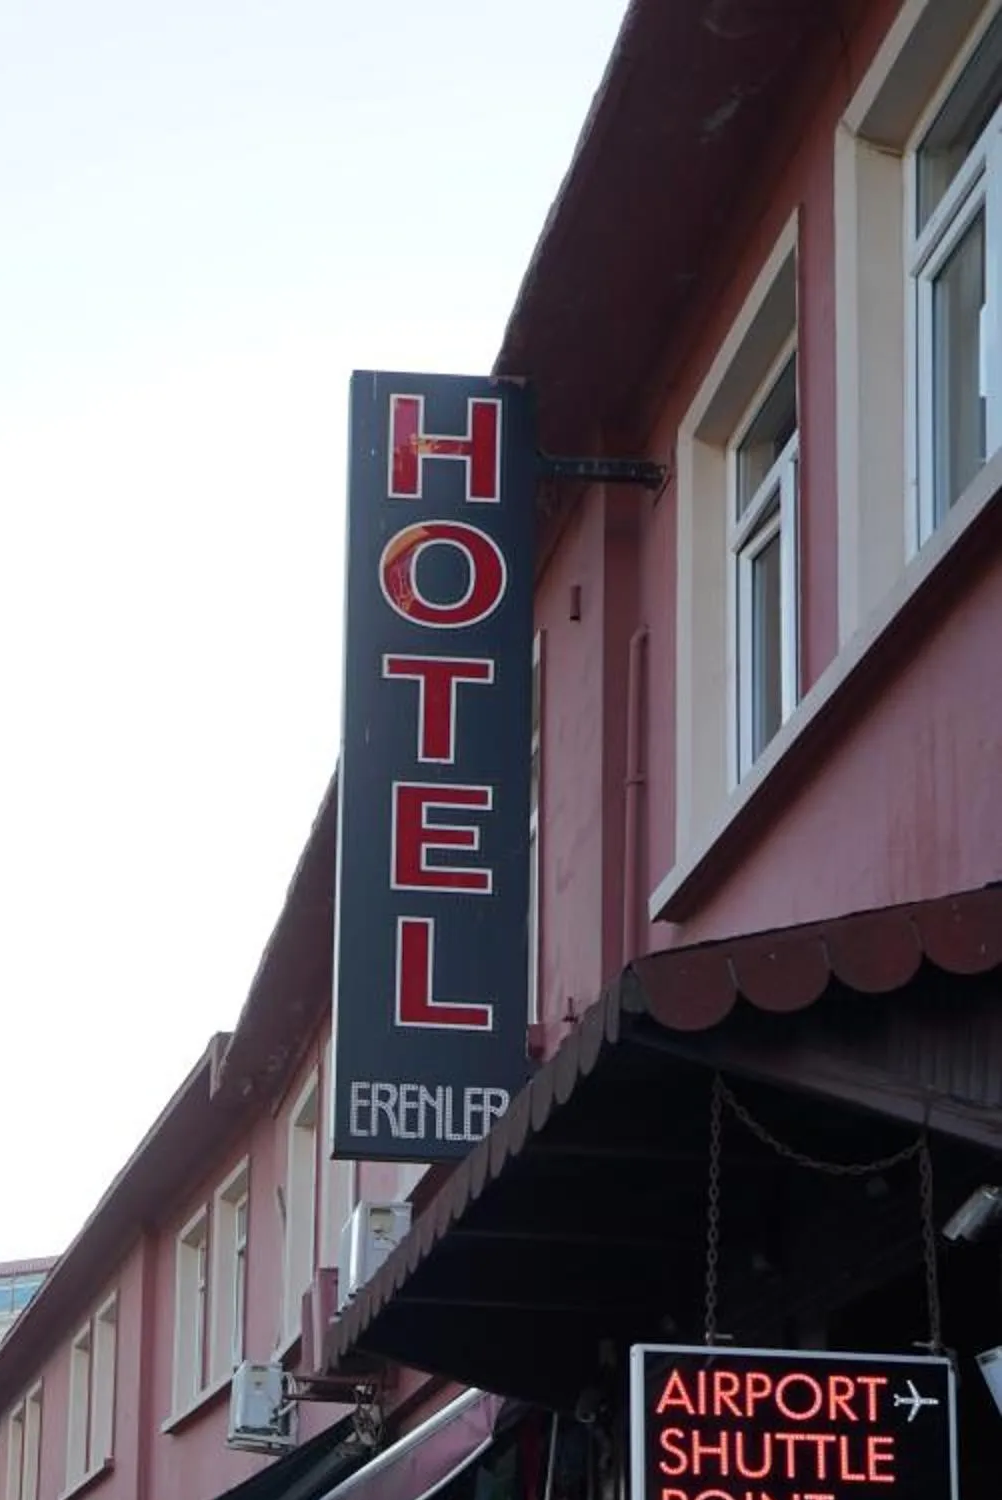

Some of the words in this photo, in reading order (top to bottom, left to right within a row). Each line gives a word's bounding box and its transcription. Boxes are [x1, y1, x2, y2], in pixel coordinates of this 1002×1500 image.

[379, 393, 507, 1031] HOTEL
[349, 1081, 510, 1141] ERENLER
[655, 1369, 888, 1422] AIRPORT
[658, 1427, 896, 1483] SHUTTLE
